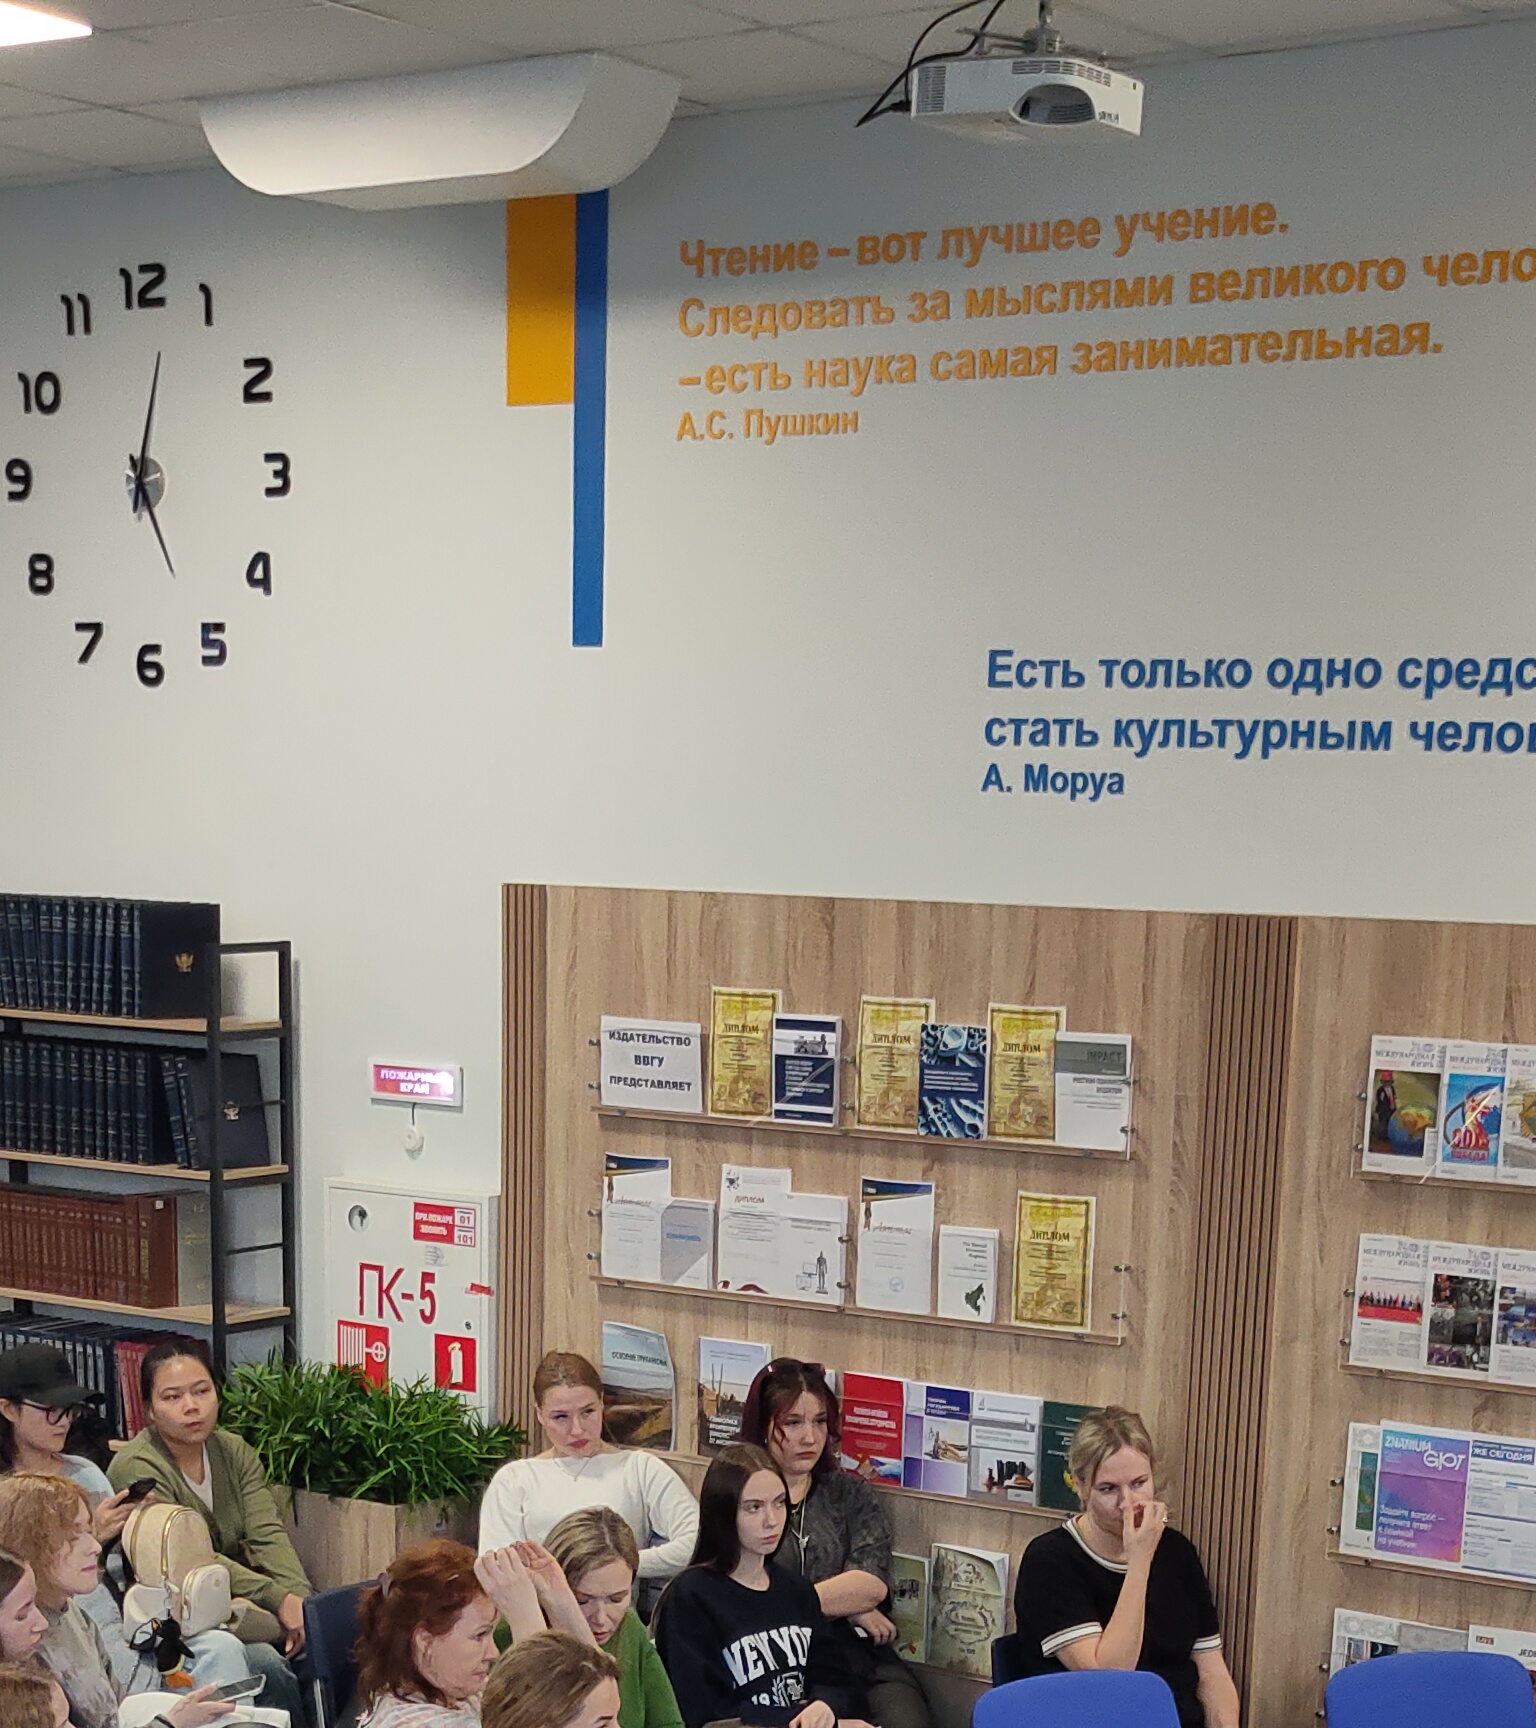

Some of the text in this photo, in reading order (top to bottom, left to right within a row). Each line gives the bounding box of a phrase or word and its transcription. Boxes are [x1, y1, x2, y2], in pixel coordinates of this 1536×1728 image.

[680, 240, 818, 277] Чтение
[939, 216, 1101, 268] лучшее
[1114, 202, 1287, 257] учение.
[119, 263, 166, 310] 12
[199, 282, 213, 327] 1
[678, 295, 894, 340] Следовать
[908, 290, 950, 323] за
[965, 274, 1173, 318] мыслями
[1190, 257, 1406, 303] великого
[61, 293, 92, 336] 11
[242, 357, 273, 404] 2
[804, 353, 916, 397] наука
[930, 344, 1057, 381] самая
[1071, 321, 1443, 374] занимательная.
[17, 371, 62, 415] 10
[676, 408, 859, 445] А.С. Пушкин
[5, 458, 33, 501] 9
[264, 452, 291, 498] 3
[28, 553, 55, 596] 8
[246, 550, 272, 596] 4
[74, 622, 104, 664] 7
[200, 622, 227, 667] 5
[136, 643, 165, 688] 6
[987, 649, 1085, 689] Есть
[1099, 658, 1252, 689] только
[1267, 657, 1382, 696] одно
[984, 717, 1099, 748] стать
[1113, 719, 1393, 761] культурным
[982, 763, 1125, 802] А. Моруа
[609, 1031, 691, 1047] ИЗДАТЕЛЬСТВО
[381, 1070, 453, 1083] ПОЖАРН
[634, 1055, 665, 1067] ВВГУ
[400, 1083, 429, 1094] КРАН
[609, 1075, 691, 1091] ПРЕДСТАВЛЯЕТ
[457, 1235, 473, 1244] 101
[459, 1216, 470, 1224] 01
[358, 1262, 438, 1325] ПК-5
[1385, 1436, 1431, 1452] ZNANIUM
[1489, 1450, 1533, 1462] СЕГОДНЯ
